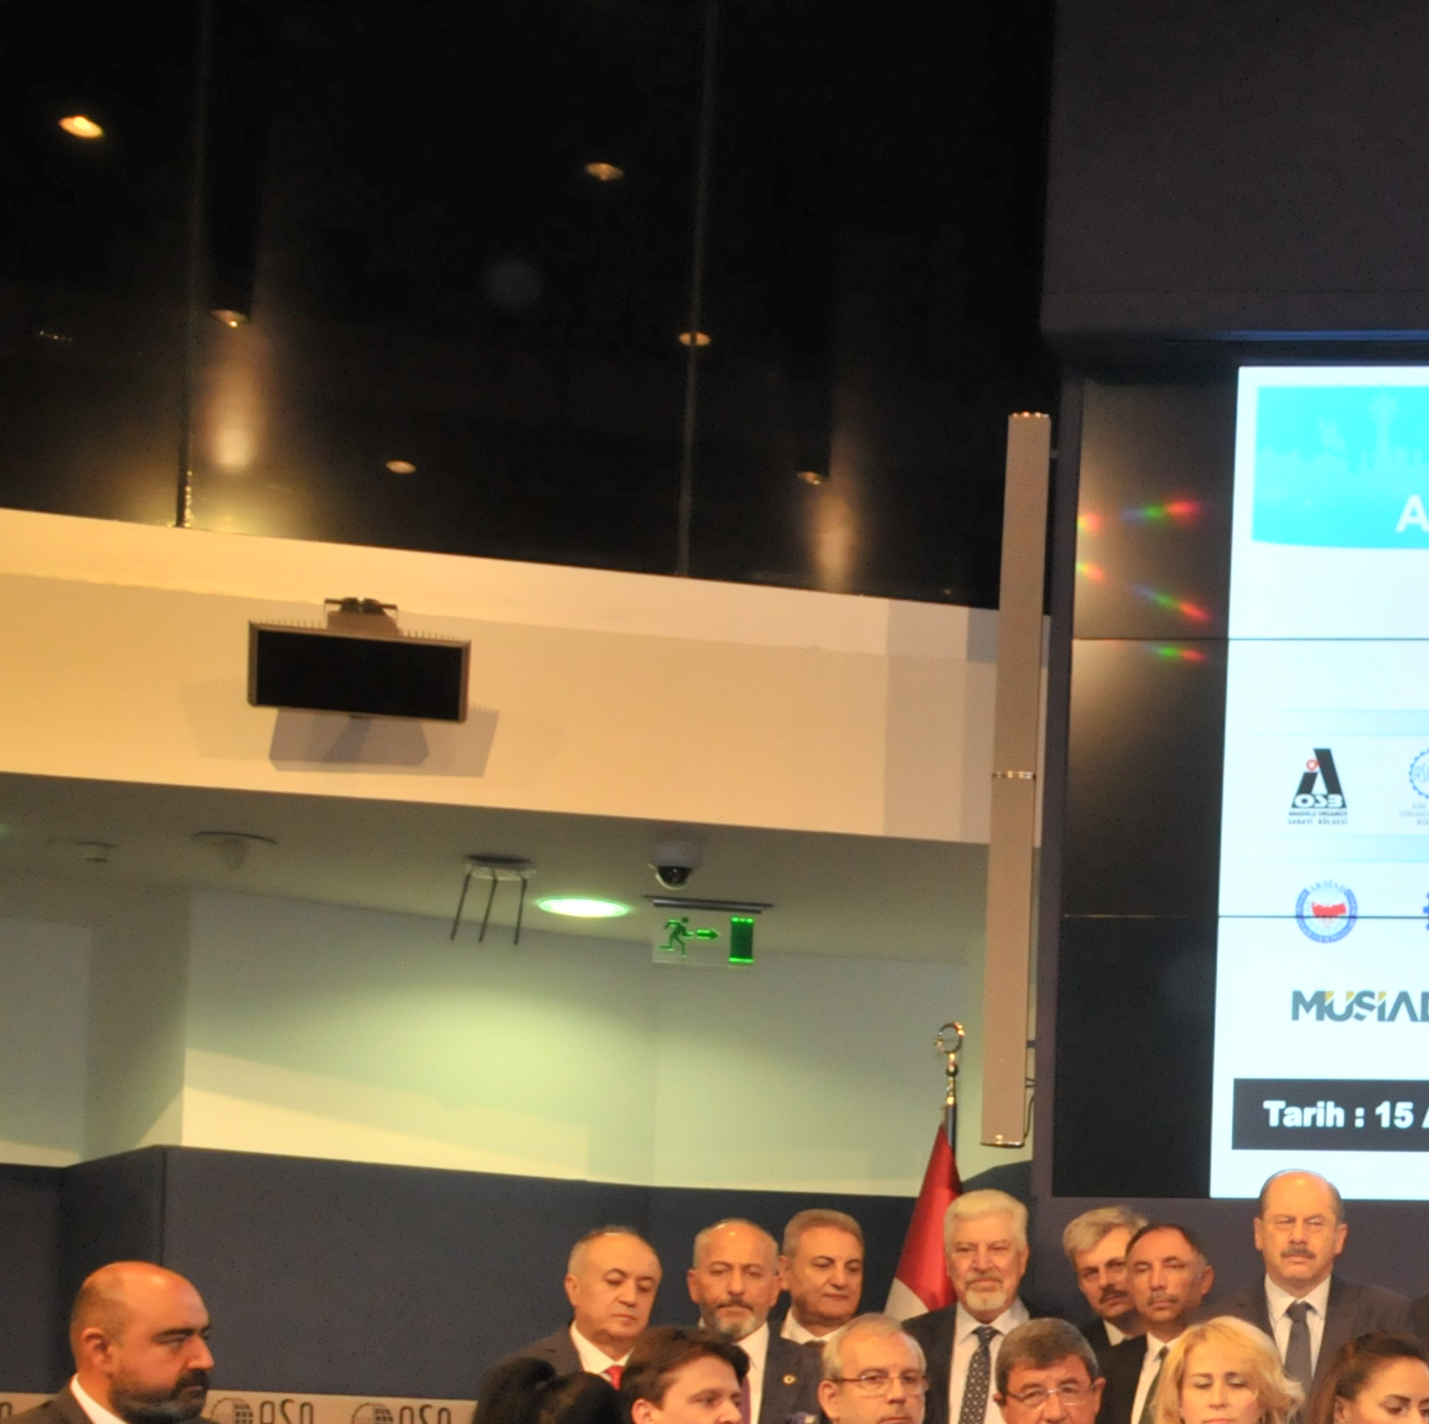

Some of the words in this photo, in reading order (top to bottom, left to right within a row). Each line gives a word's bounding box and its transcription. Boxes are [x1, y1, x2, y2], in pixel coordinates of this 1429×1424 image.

[1294, 793, 1344, 808] OSB
[1263, 1100, 1345, 1128] Tarih
[1375, 1102, 1414, 1129] 15
